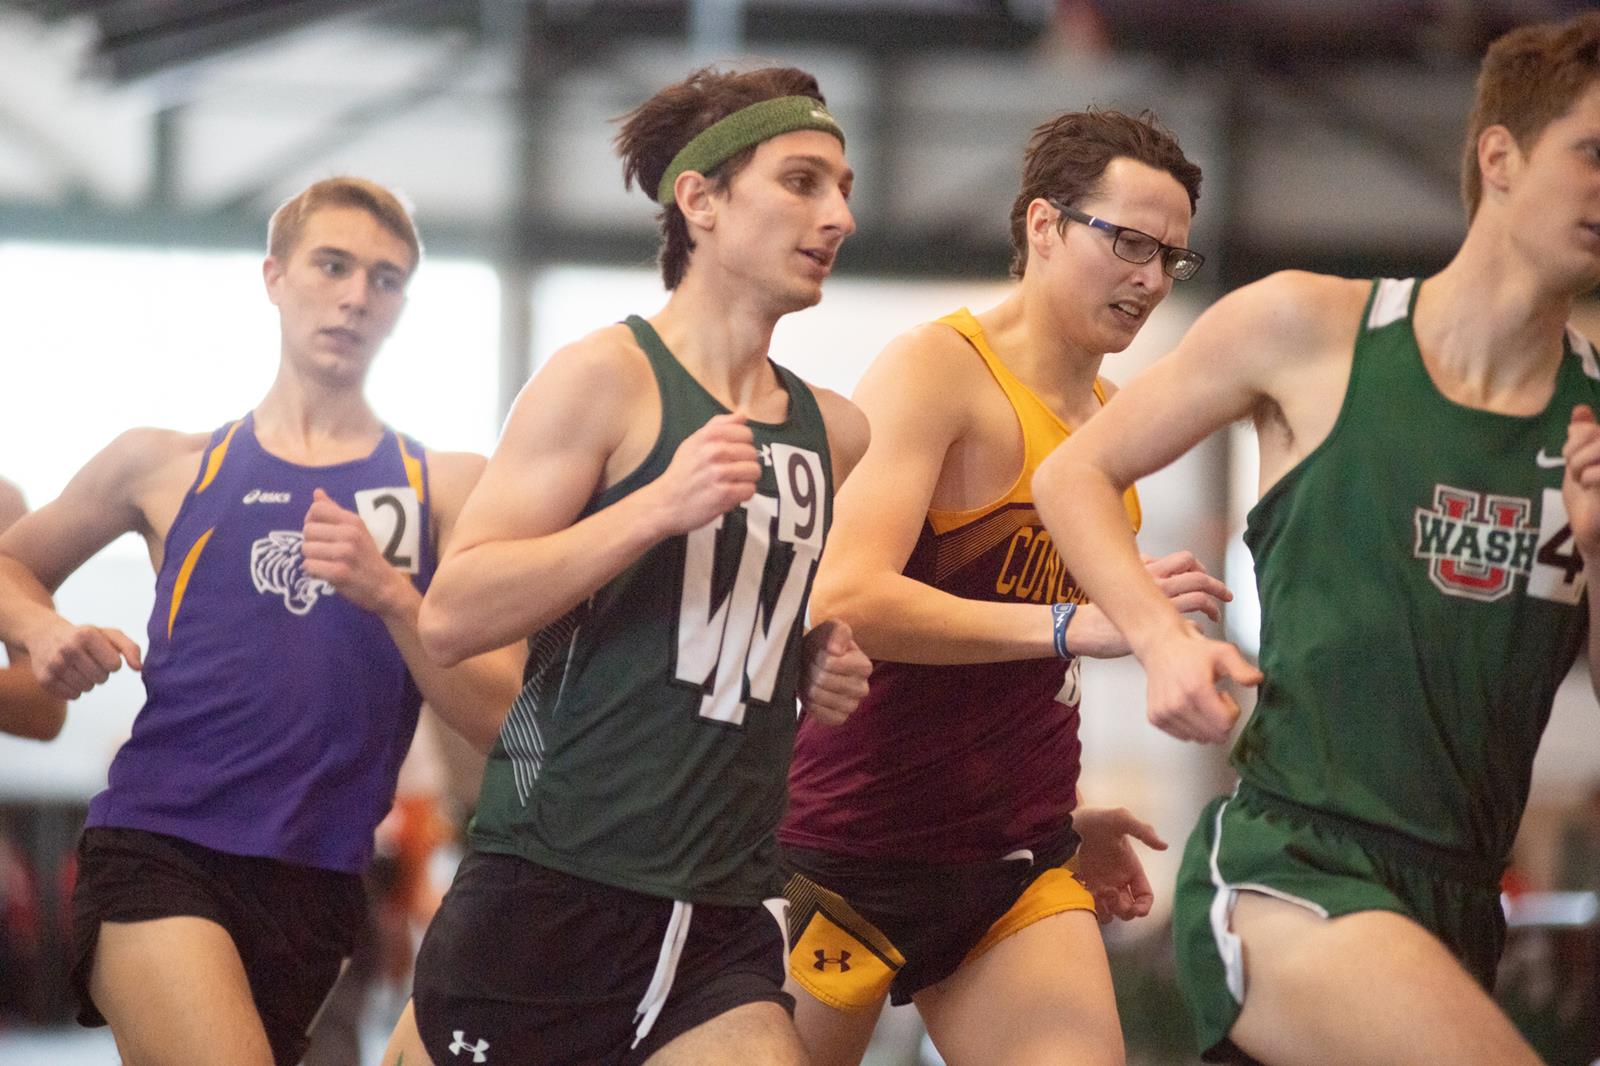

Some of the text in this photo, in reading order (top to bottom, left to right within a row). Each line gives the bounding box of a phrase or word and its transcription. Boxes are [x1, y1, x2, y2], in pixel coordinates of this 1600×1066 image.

[788, 452, 817, 541] 9
[372, 494, 412, 568] 2
[1415, 511, 1540, 573] WASH
[1536, 522, 1585, 585] 4
